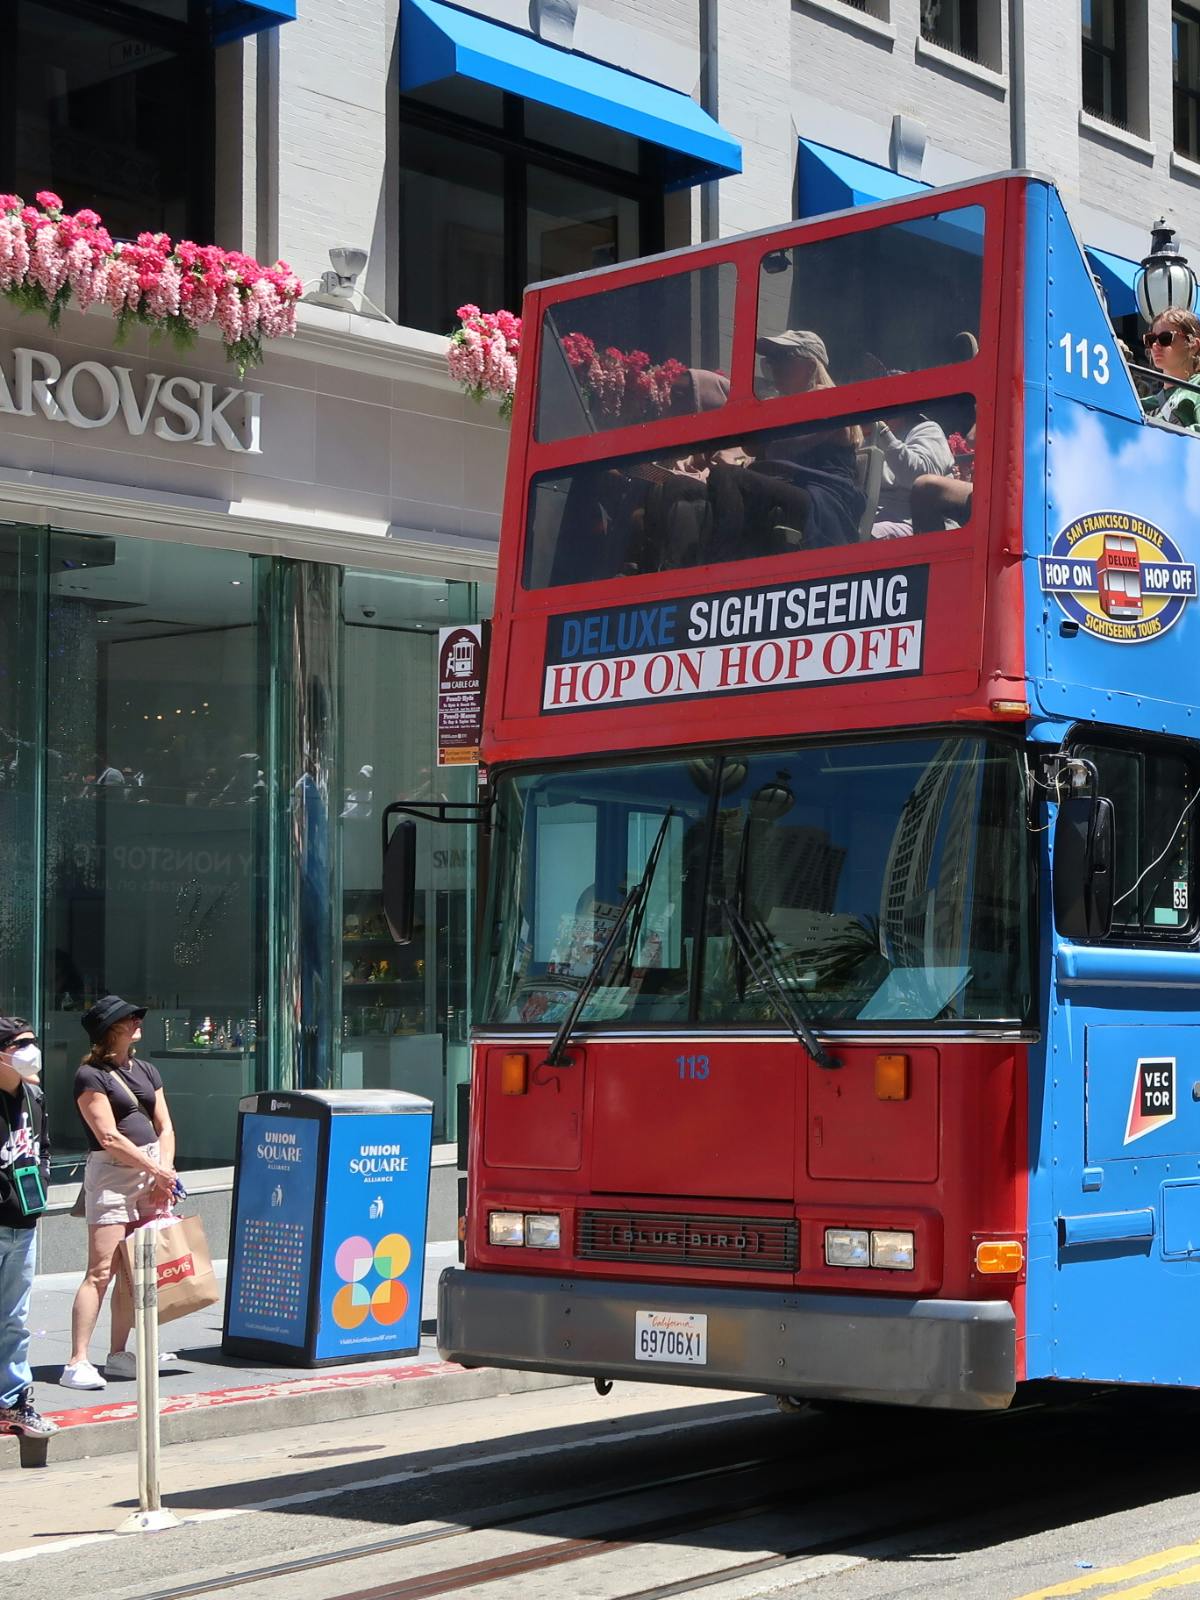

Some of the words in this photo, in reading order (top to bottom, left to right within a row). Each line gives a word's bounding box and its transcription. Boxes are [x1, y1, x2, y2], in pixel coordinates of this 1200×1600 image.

[1059, 332, 1110, 385] 113
[1066, 526, 1084, 545] SAN
[1083, 515, 1130, 533] FRANCISCO
[1131, 518, 1164, 548] DELUXE
[1108, 554, 1137, 568] DELUXE
[1045, 563, 1070, 586] HOP
[1073, 565, 1093, 586] ON
[1144, 568, 1170, 590] HOP
[1172, 570, 1192, 590] OFF
[561, 605, 678, 658] DELUXE
[688, 574, 908, 642] SIGHTSEEING
[1084, 613, 1137, 639] SIGHTSEEING
[1138, 619, 1162, 638] TOURS
[550, 659, 636, 706] HOP
[643, 651, 706, 695] ON
[716, 637, 813, 688] HOP
[822, 624, 916, 675] OFF
[469, 680, 480, 688] CAR
[1174, 888, 1187, 907] 35
[675, 1055, 710, 1080] 113
[1144, 1072, 1169, 1087] VEC
[1145, 1091, 1170, 1107] TOR
[265, 1131, 296, 1145] UNION
[256, 1144, 302, 1163] SQUARE
[360, 1144, 401, 1157] UNION
[267, 1163, 290, 1172] ALLIANCE
[349, 1157, 409, 1177] SQUARE
[623, 1231, 678, 1245] BLUE
[691, 1233, 746, 1249] BIRD
[651, 1315, 694, 1329] California
[640, 1329, 701, 1357] 69706X1
